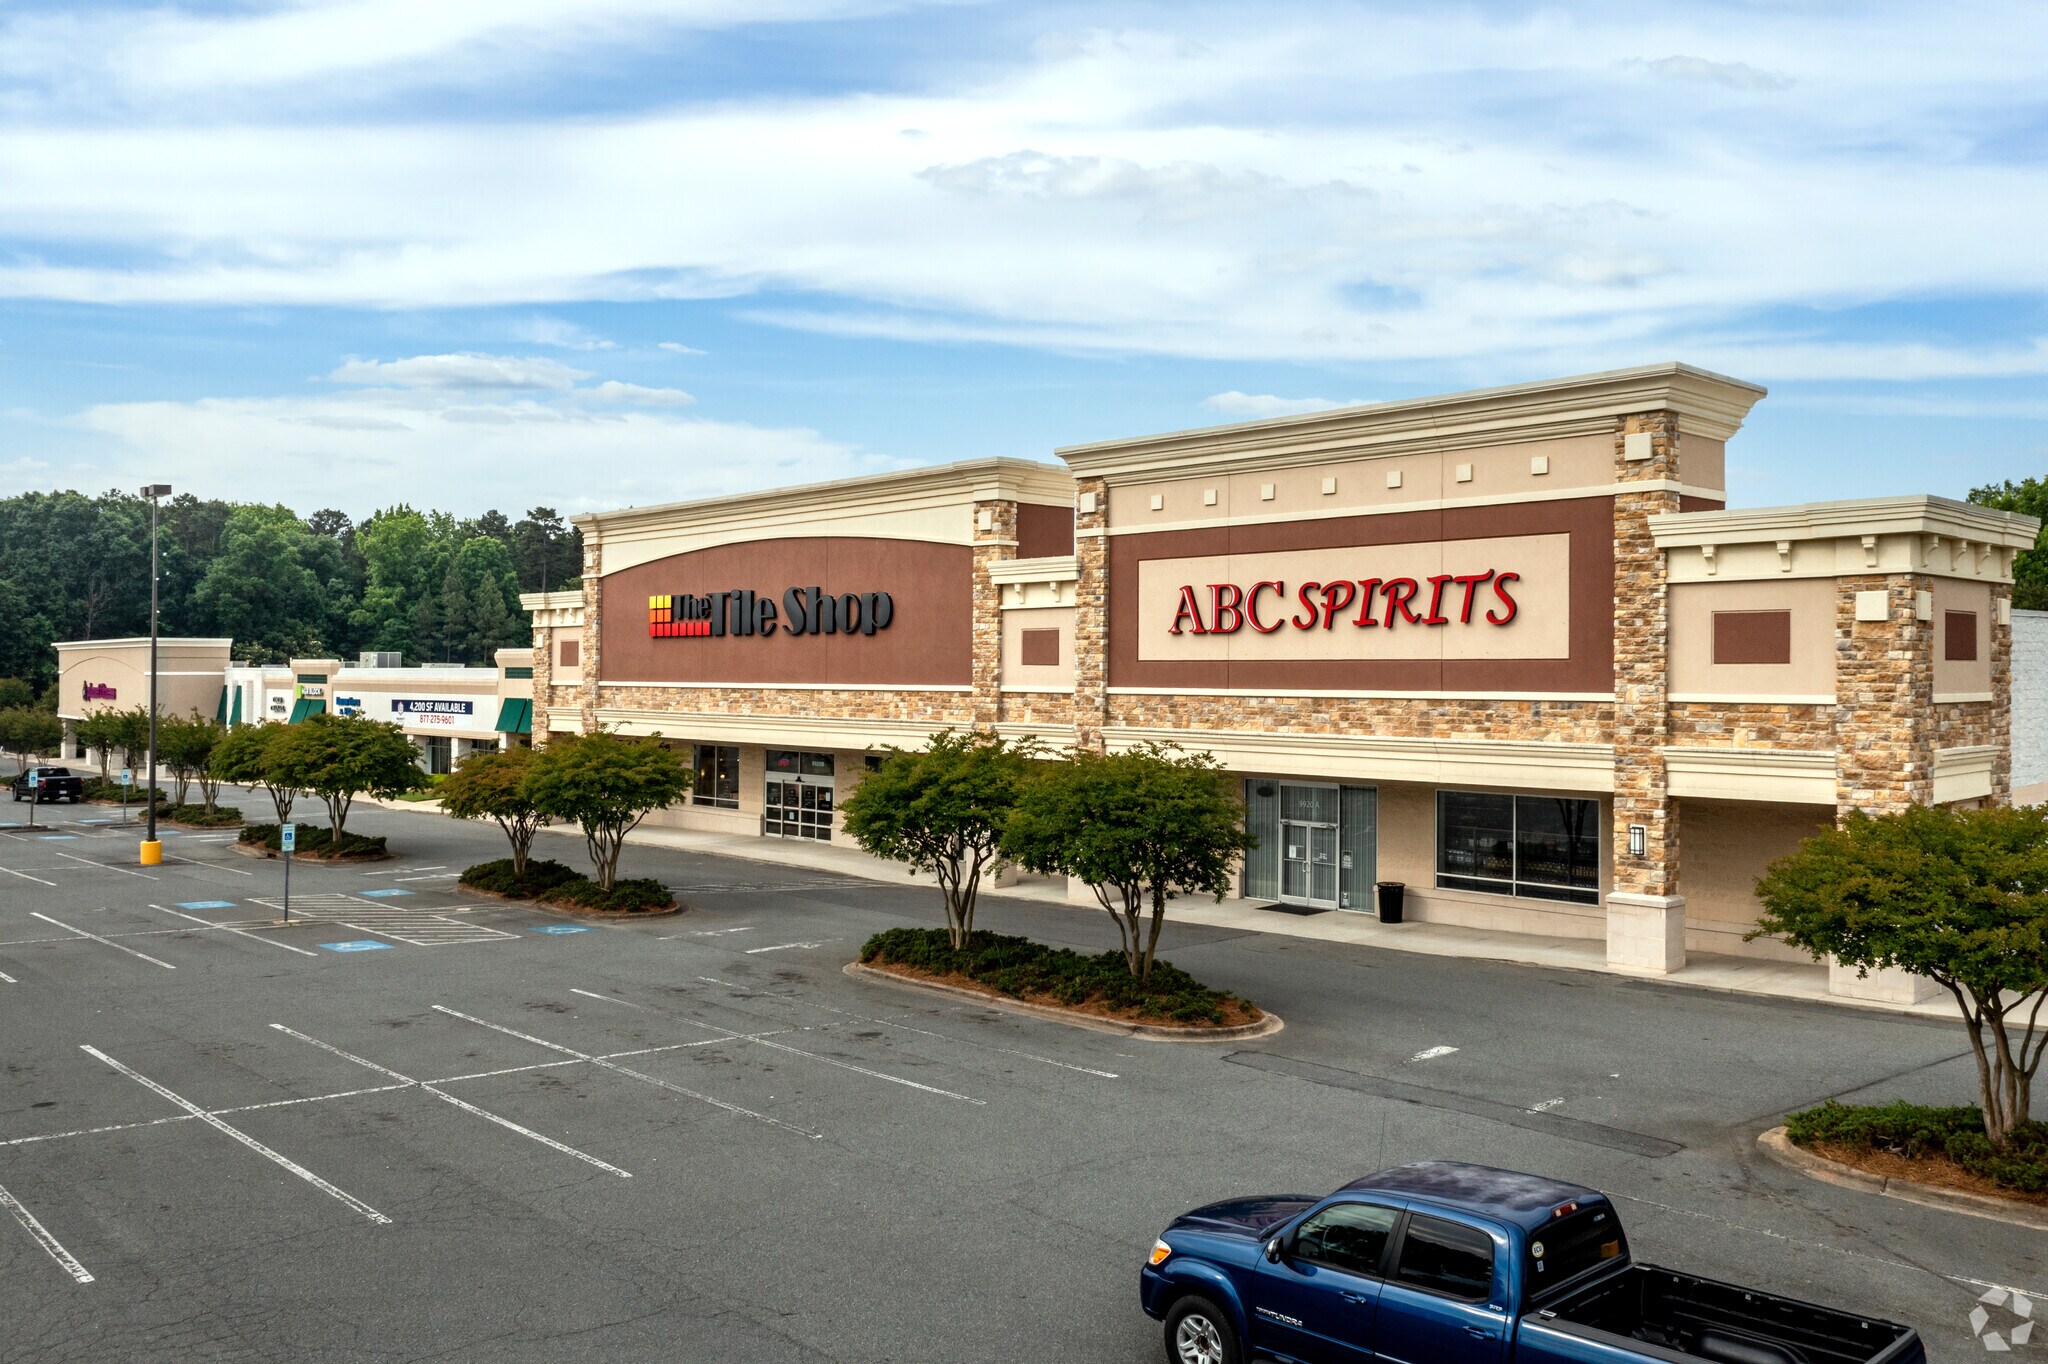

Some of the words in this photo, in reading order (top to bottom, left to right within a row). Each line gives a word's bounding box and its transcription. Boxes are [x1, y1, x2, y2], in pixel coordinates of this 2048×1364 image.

[1168, 580, 1285, 634] ABC
[1292, 569, 1520, 629] SPIRITS
[673, 594, 711, 619] The
[707, 589, 777, 636] Tile
[783, 586, 893, 635] Shop
[409, 701, 425, 713] 4,200
[426, 702, 434, 712] SF
[434, 702, 466, 713] AVAILABLE
[419, 714, 455, 725] 877-275-9601
[1270, 1310, 1303, 1327] TUNDRA
